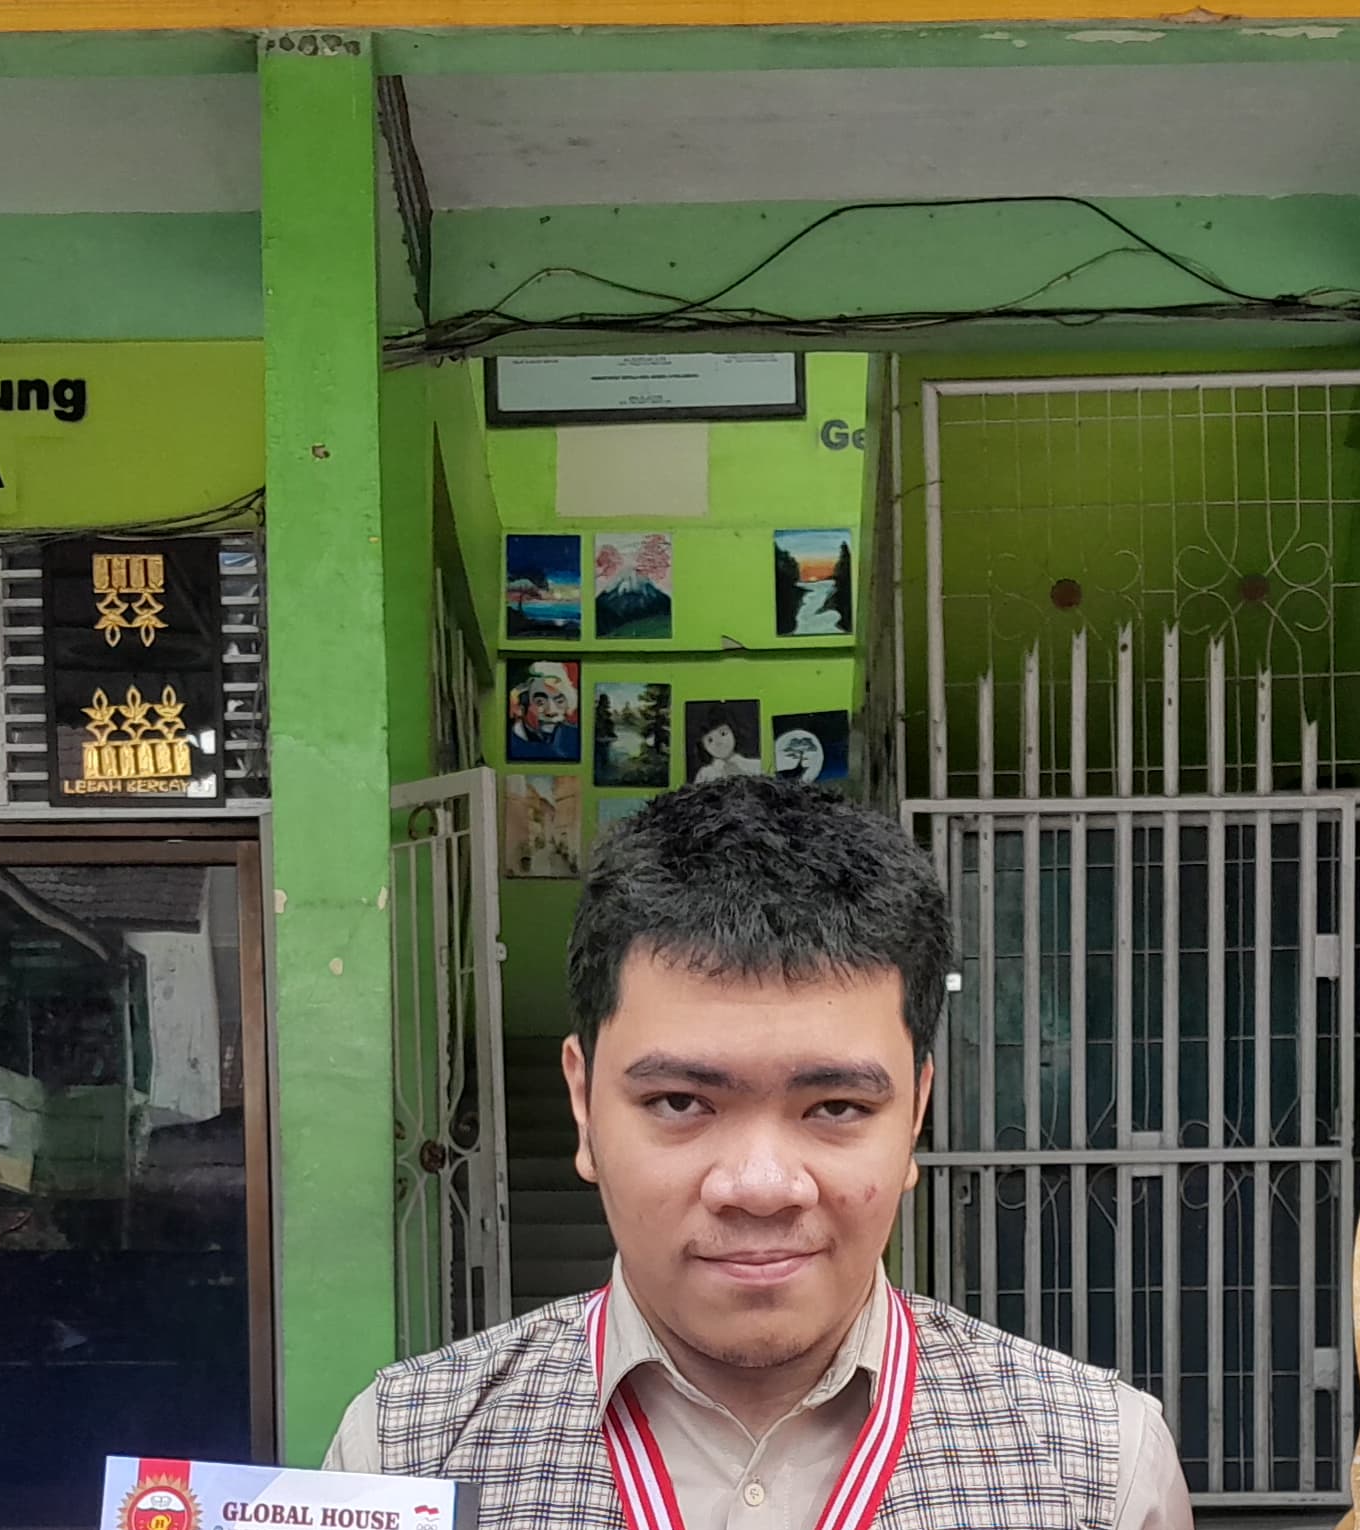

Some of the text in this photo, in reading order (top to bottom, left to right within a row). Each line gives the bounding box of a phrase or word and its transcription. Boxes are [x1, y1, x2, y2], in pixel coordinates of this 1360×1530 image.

[63, 779, 121, 794] LEBAH
[222, 1501, 400, 1530] GLOBAL HOUSE
